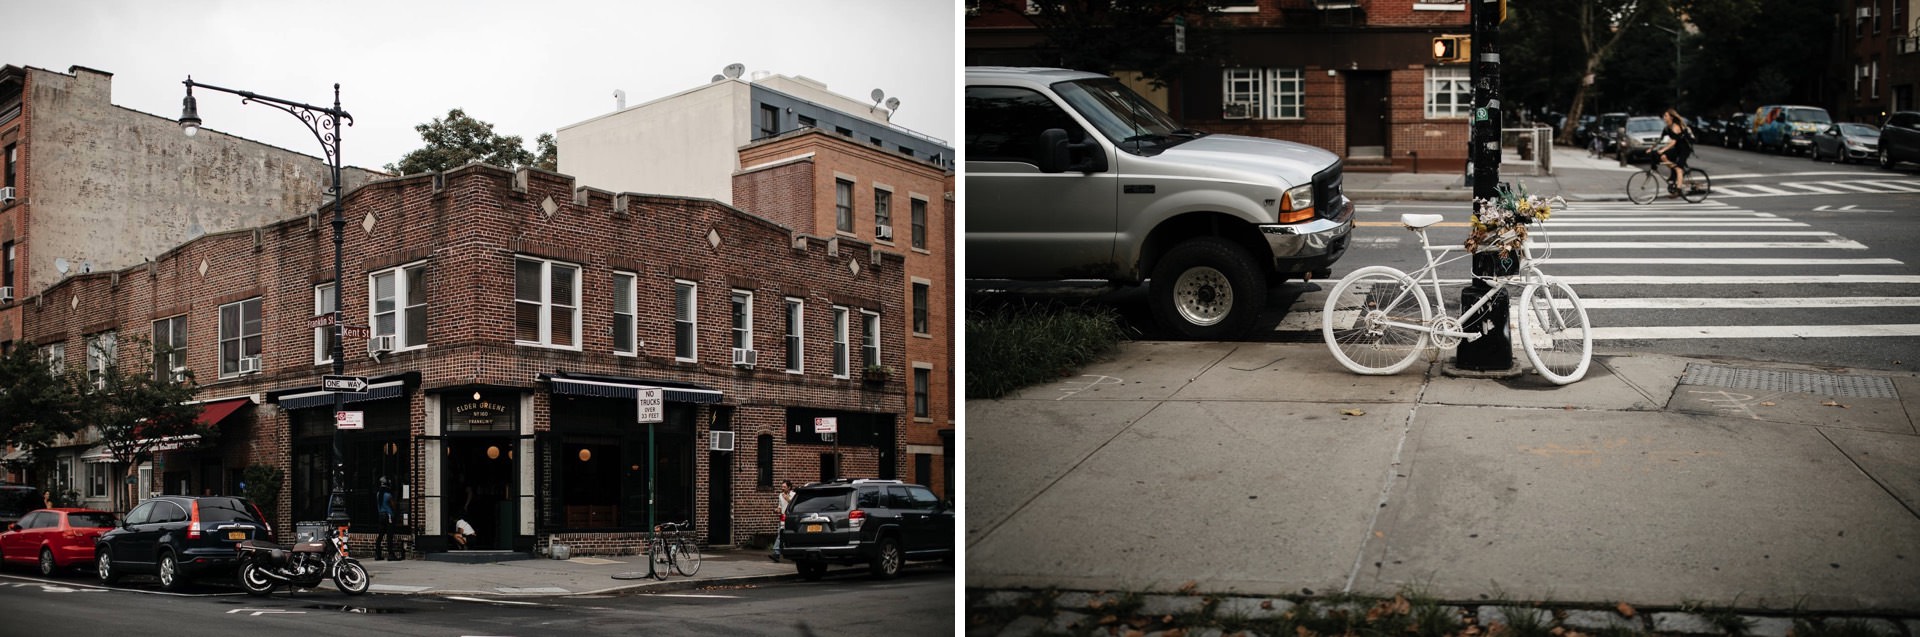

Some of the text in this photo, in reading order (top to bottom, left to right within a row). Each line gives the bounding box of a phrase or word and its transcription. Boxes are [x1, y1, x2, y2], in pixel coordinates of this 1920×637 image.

[307, 316, 334, 328] Franklin St
[344, 328, 370, 338] Kent St
[456, 402, 506, 412] ELDER GREENE
